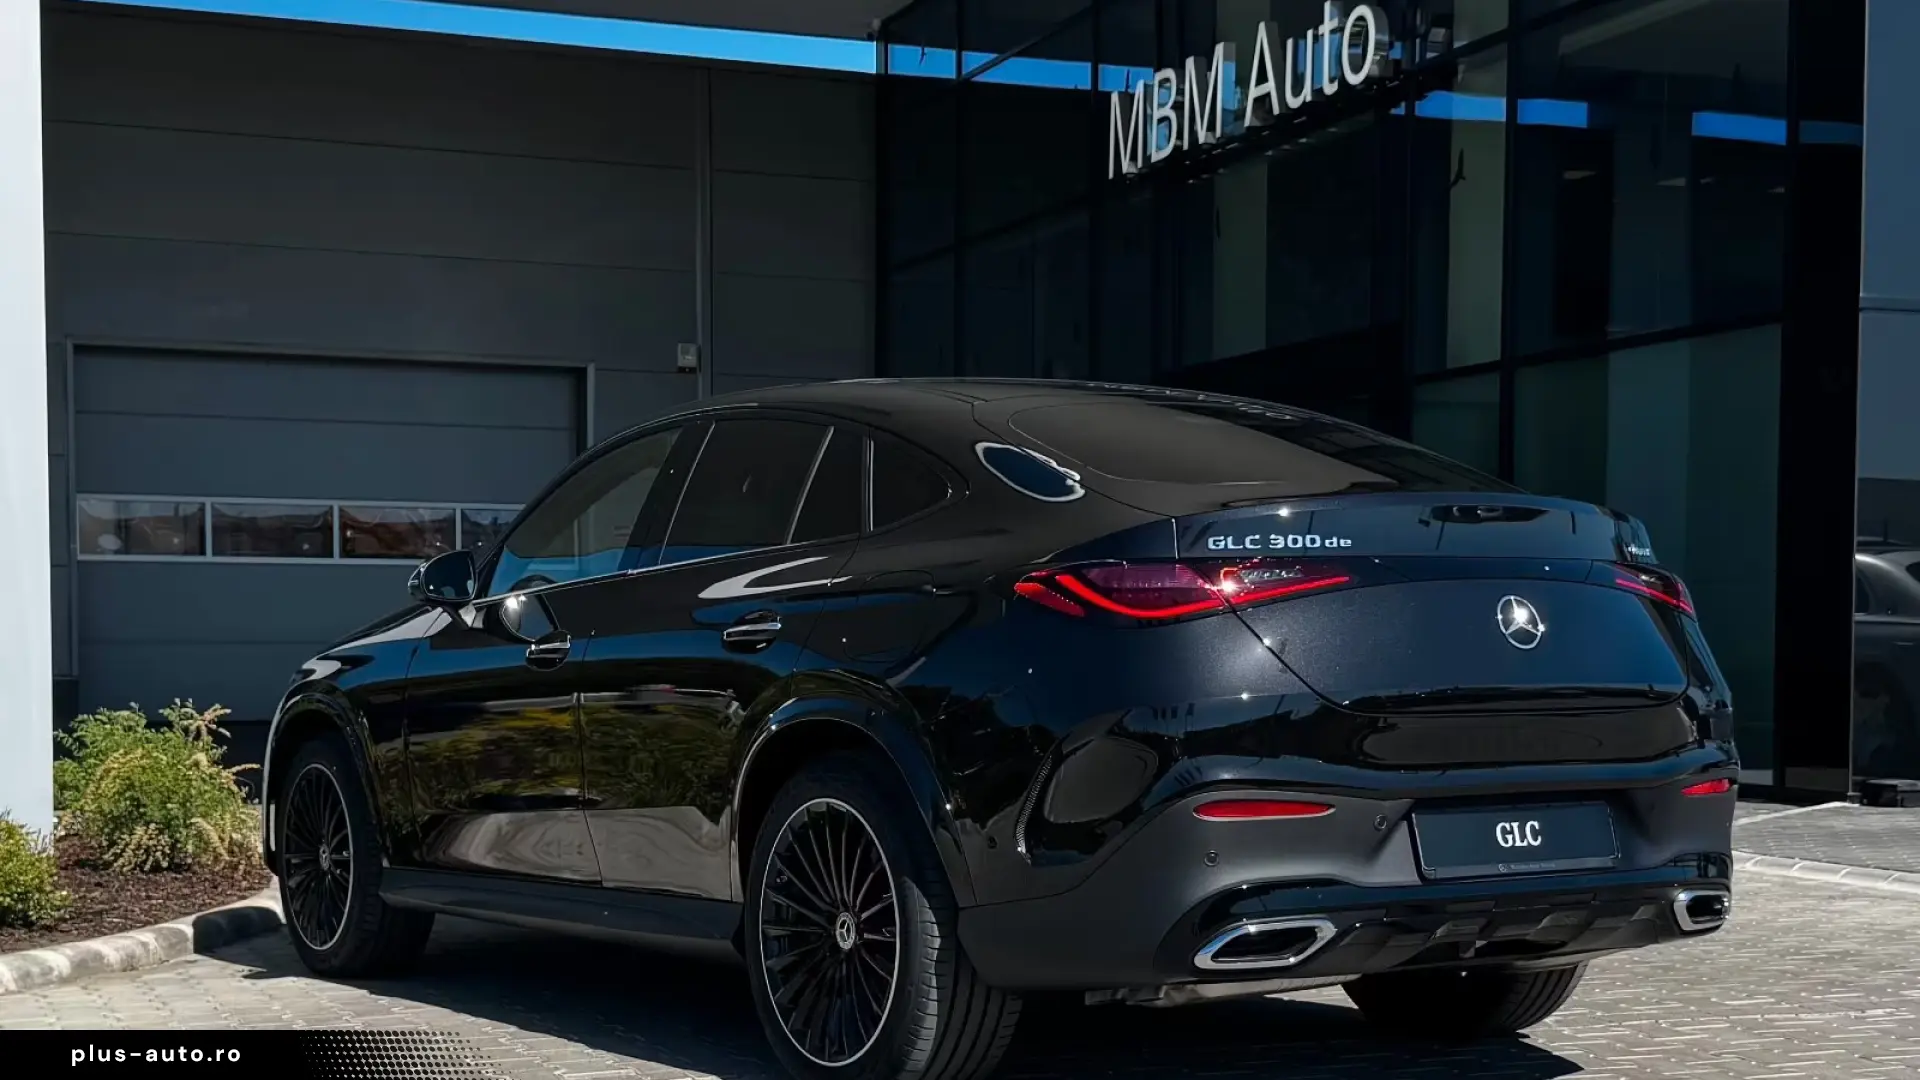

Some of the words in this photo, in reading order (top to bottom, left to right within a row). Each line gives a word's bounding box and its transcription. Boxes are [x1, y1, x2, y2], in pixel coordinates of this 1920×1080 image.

[1108, 41, 1226, 180] MBM
[1243, 0, 1377, 128] Auto
[1207, 534, 1262, 550] GLC
[1495, 820, 1542, 848] GLC
